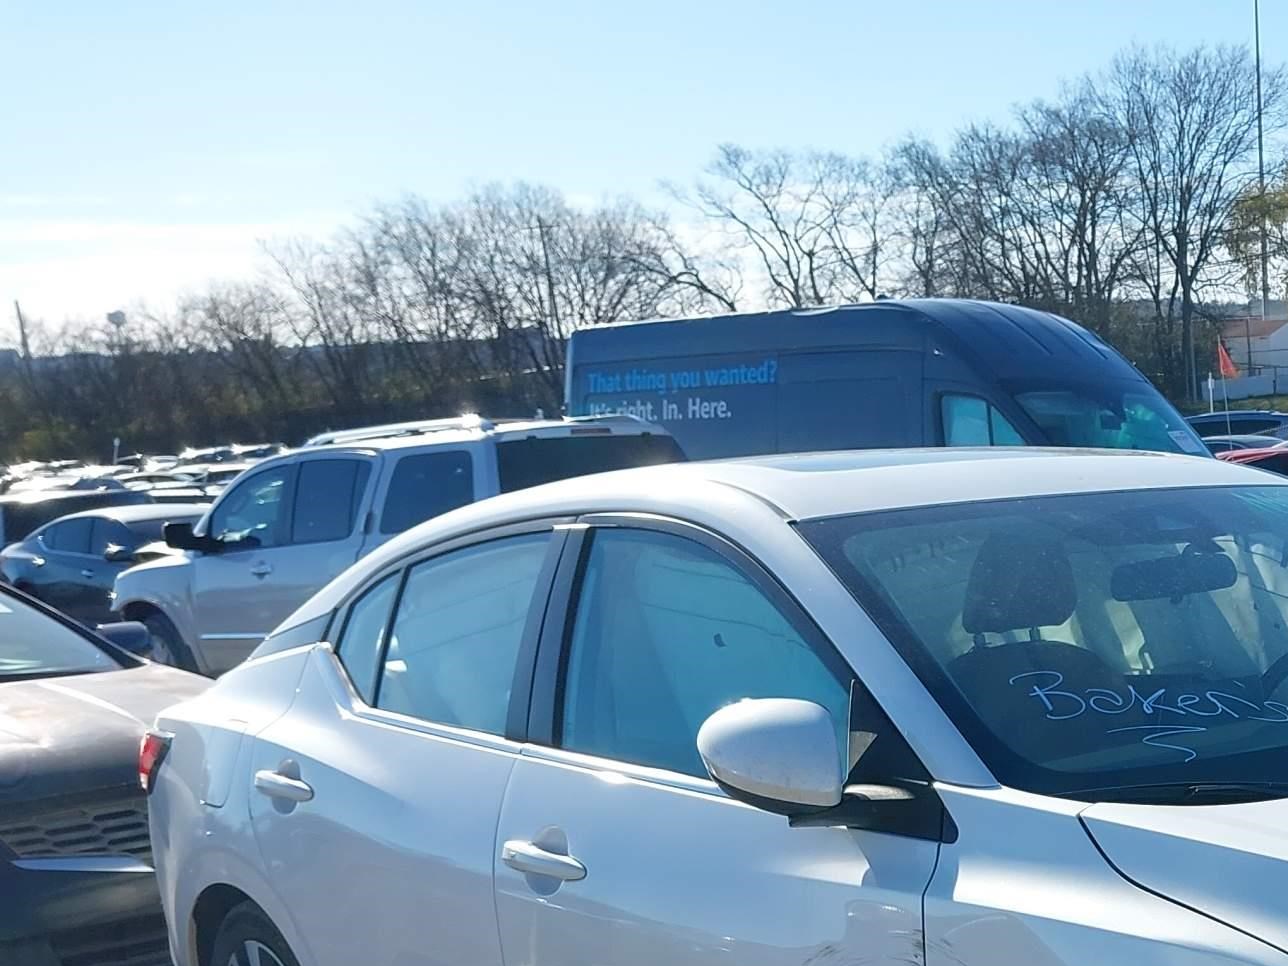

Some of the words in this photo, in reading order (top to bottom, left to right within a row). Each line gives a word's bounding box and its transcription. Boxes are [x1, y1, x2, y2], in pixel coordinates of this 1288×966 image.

[587, 372, 621, 393] That
[625, 369, 666, 396] thing
[672, 371, 700, 394] you
[704, 360, 778, 387] wanted?
[662, 399, 683, 420] In.
[688, 398, 732, 419] Here.
